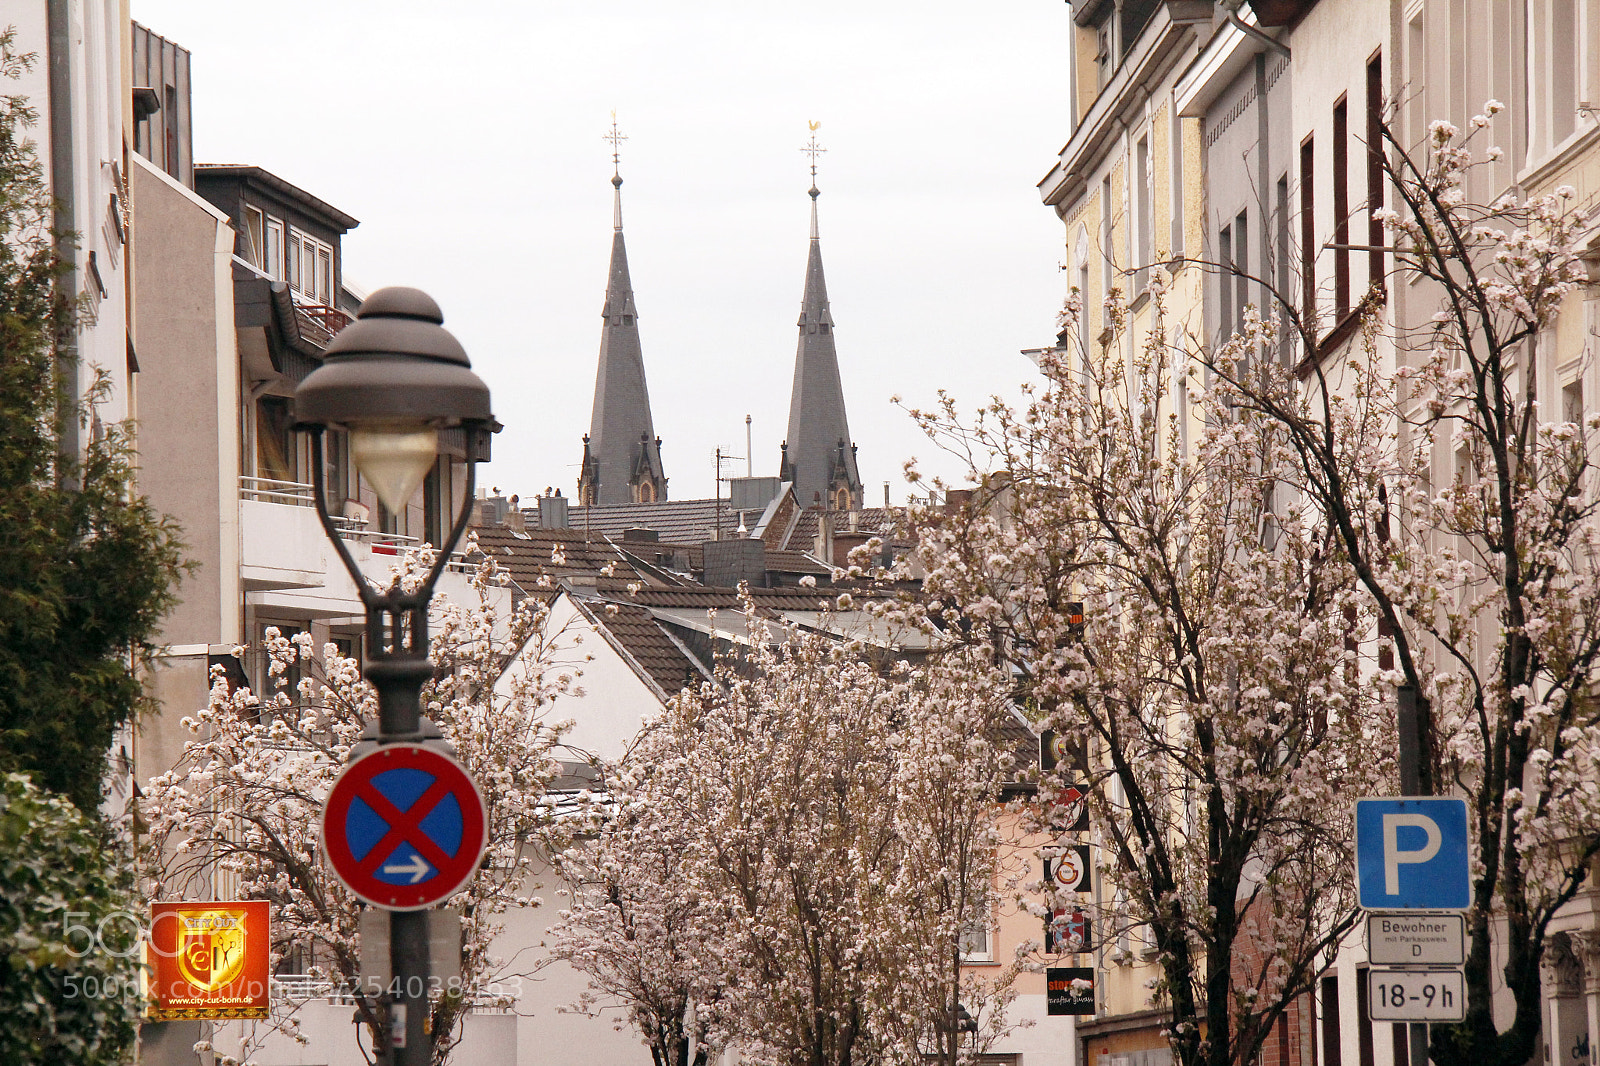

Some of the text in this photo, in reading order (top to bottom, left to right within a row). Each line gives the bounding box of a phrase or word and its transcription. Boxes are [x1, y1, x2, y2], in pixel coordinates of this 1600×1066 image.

[1382, 813, 1442, 896] P
[213, 917, 239, 928] CUT
[1382, 920, 1448, 933] Bewohner
[1412, 944, 1422, 957] D
[168, 996, 254, 1006] www.city-cut-bonn.de
